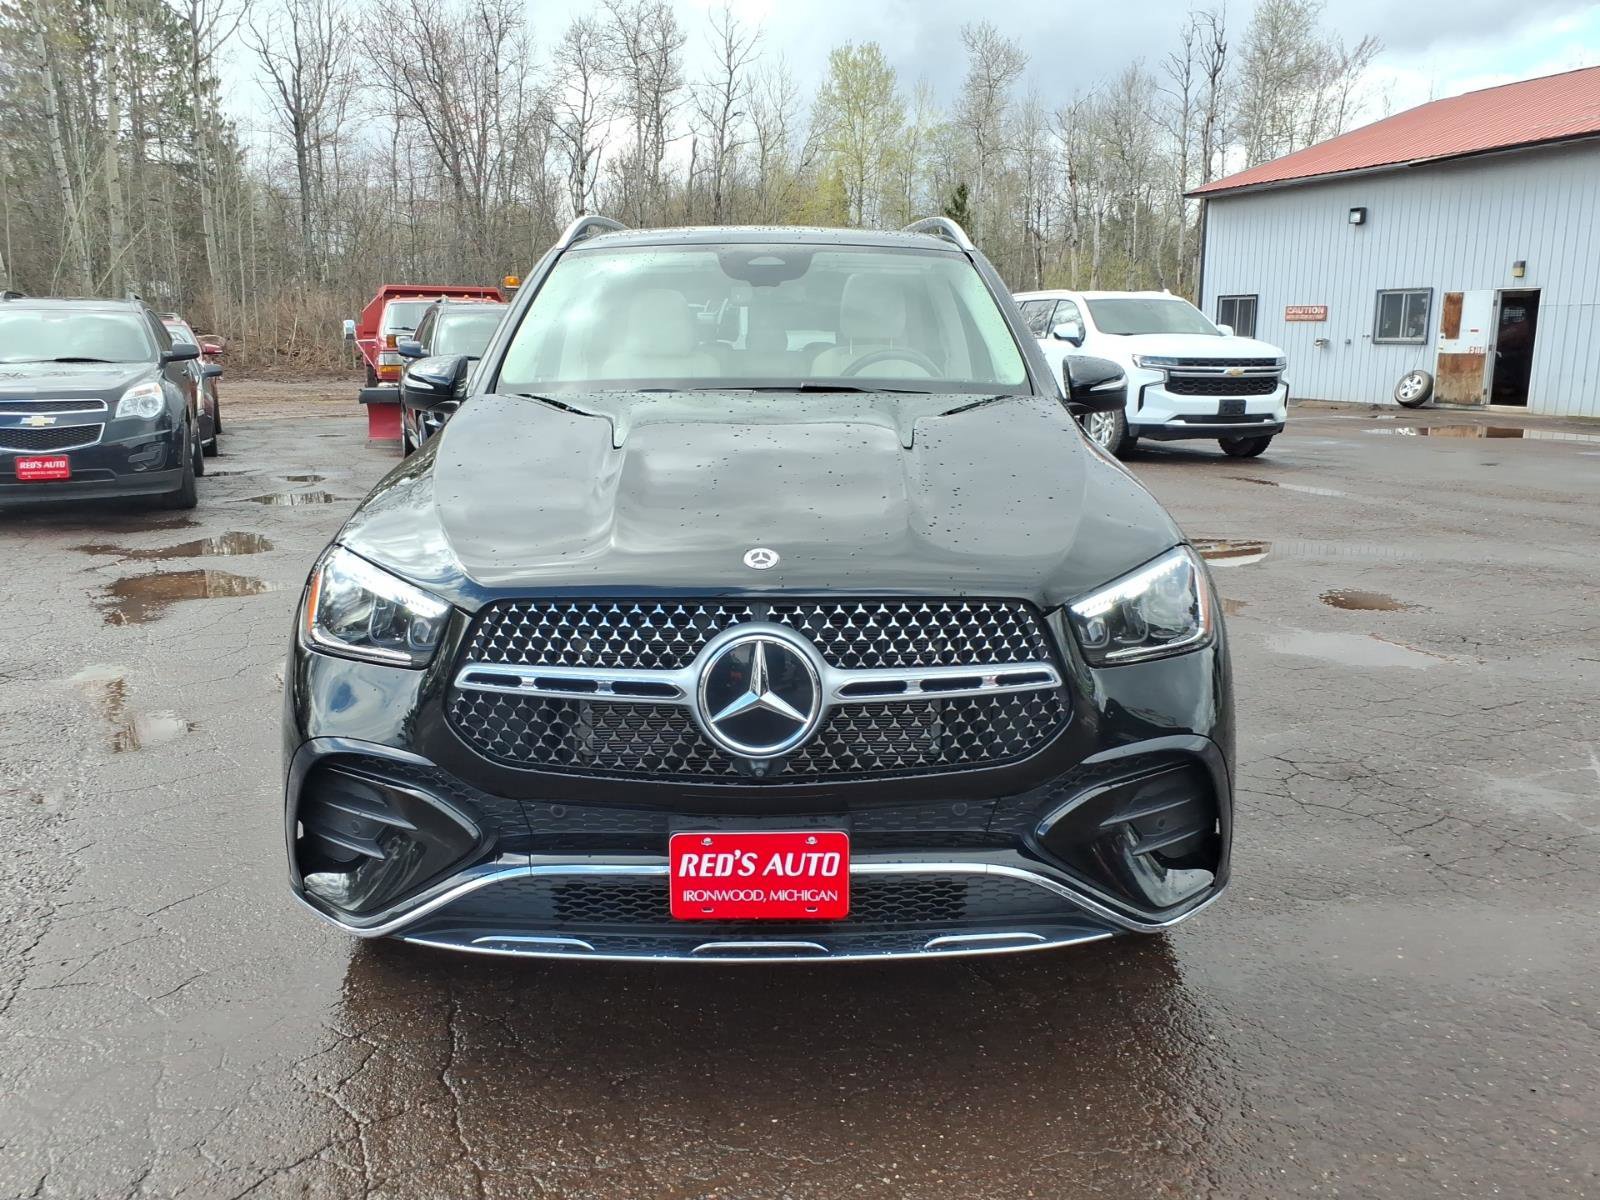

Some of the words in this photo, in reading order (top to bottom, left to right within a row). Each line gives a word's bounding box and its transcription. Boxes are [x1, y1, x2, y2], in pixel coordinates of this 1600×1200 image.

[20, 461, 42, 469] RED'S
[44, 460, 65, 468] AUTO
[678, 849, 758, 877] RED'S
[762, 852, 841, 877] AUTO
[683, 889, 767, 903] IRONWOOD,
[769, 889, 838, 902] MICHIGAN
